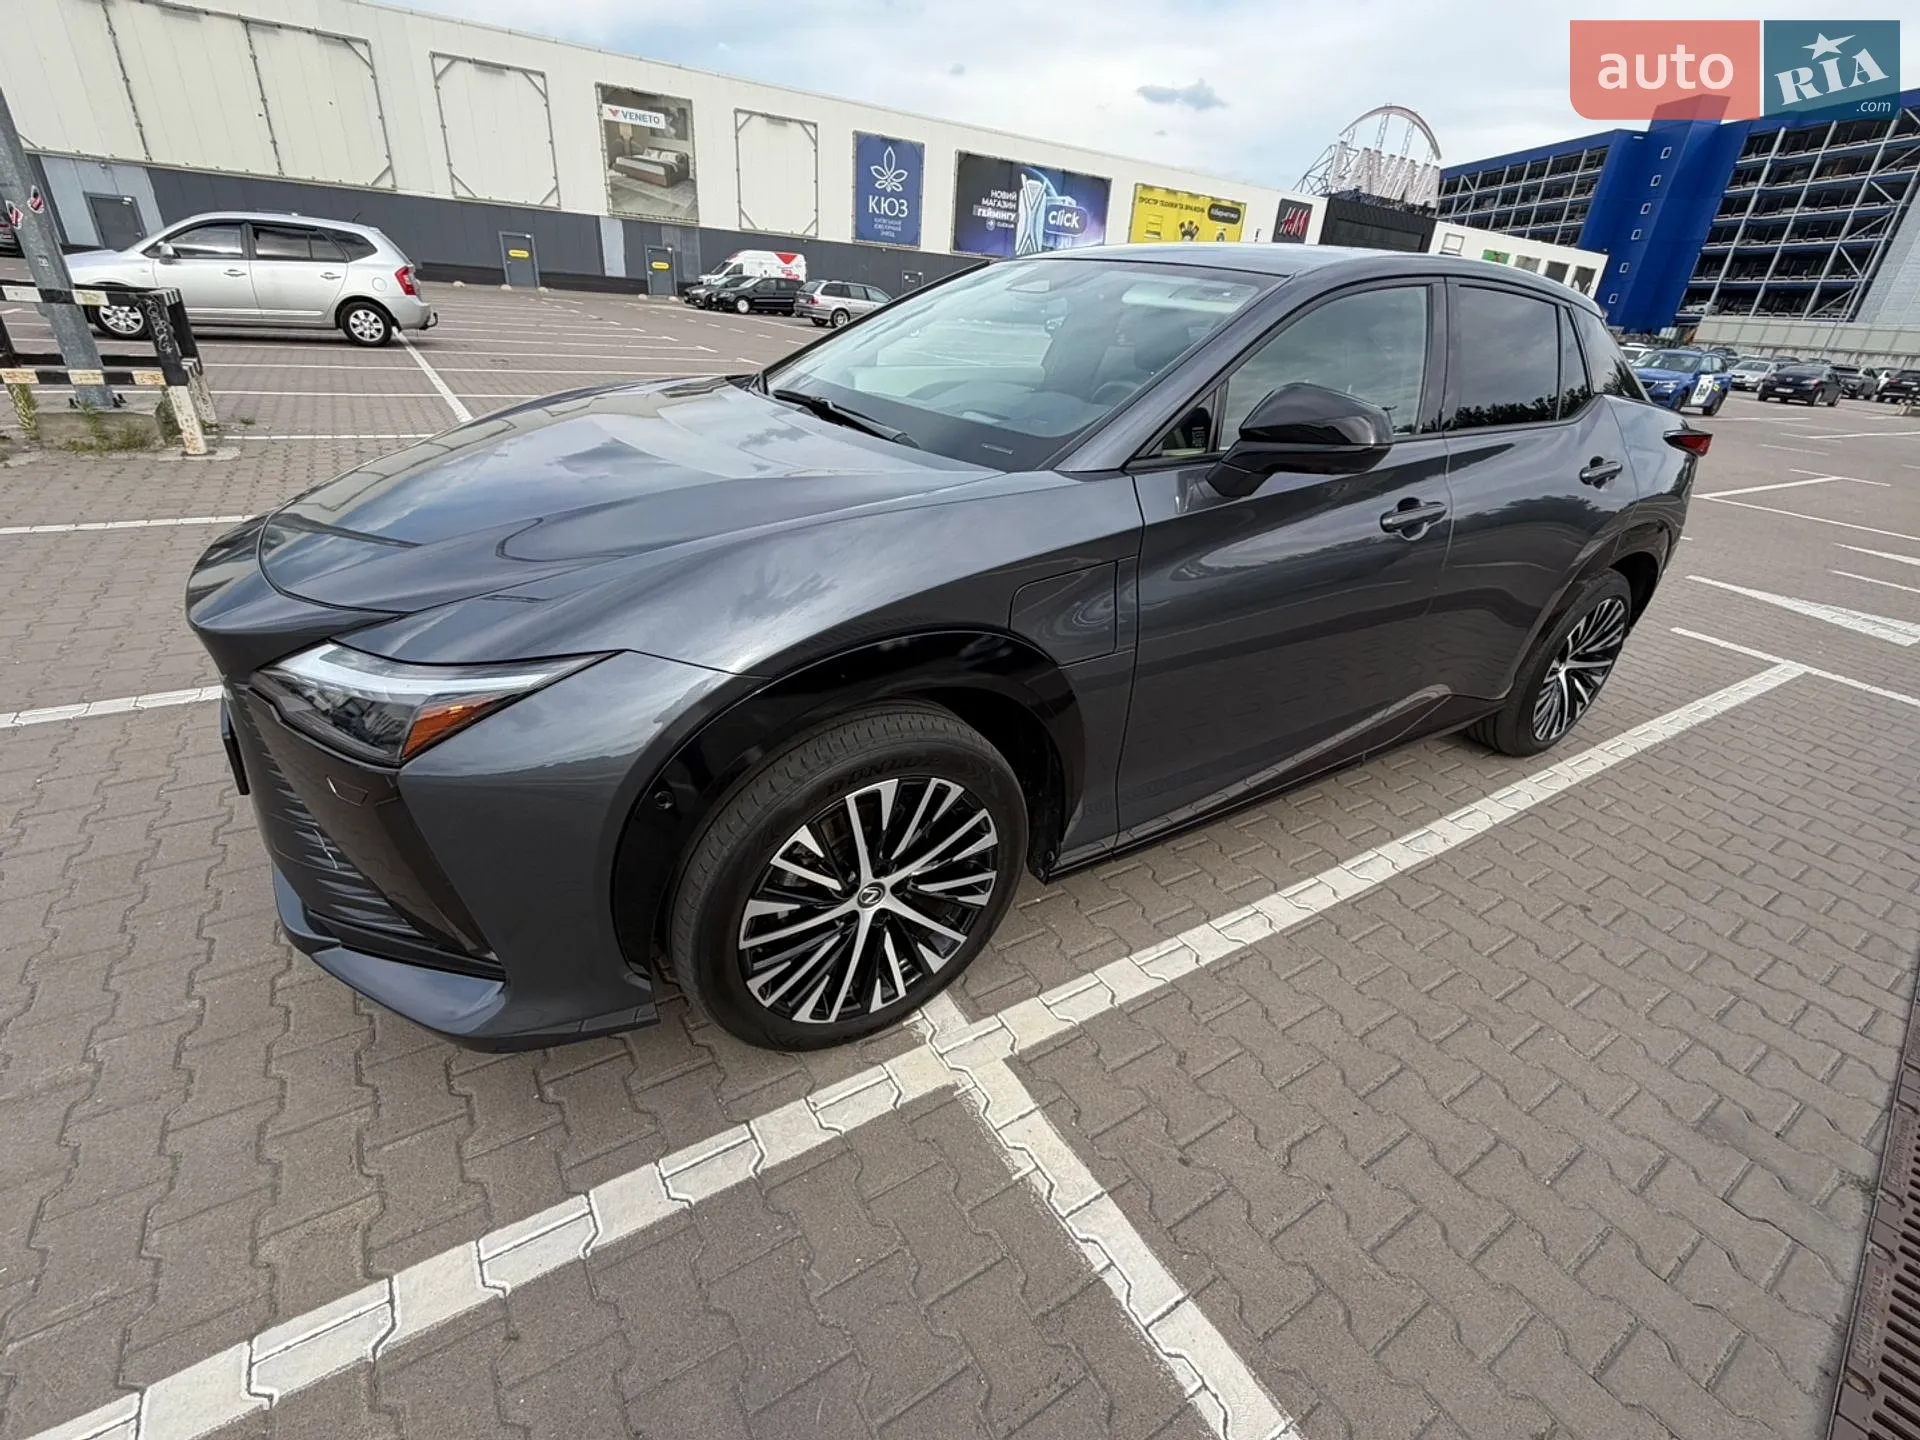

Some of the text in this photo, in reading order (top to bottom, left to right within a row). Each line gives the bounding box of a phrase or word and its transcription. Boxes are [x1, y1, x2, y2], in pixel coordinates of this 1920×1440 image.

[621, 110, 660, 124] VENETO
[991, 190, 1017, 201] НОВИЙ
[868, 195, 908, 217] КЮЗ
[982, 198, 1017, 210] МАГАЗИН
